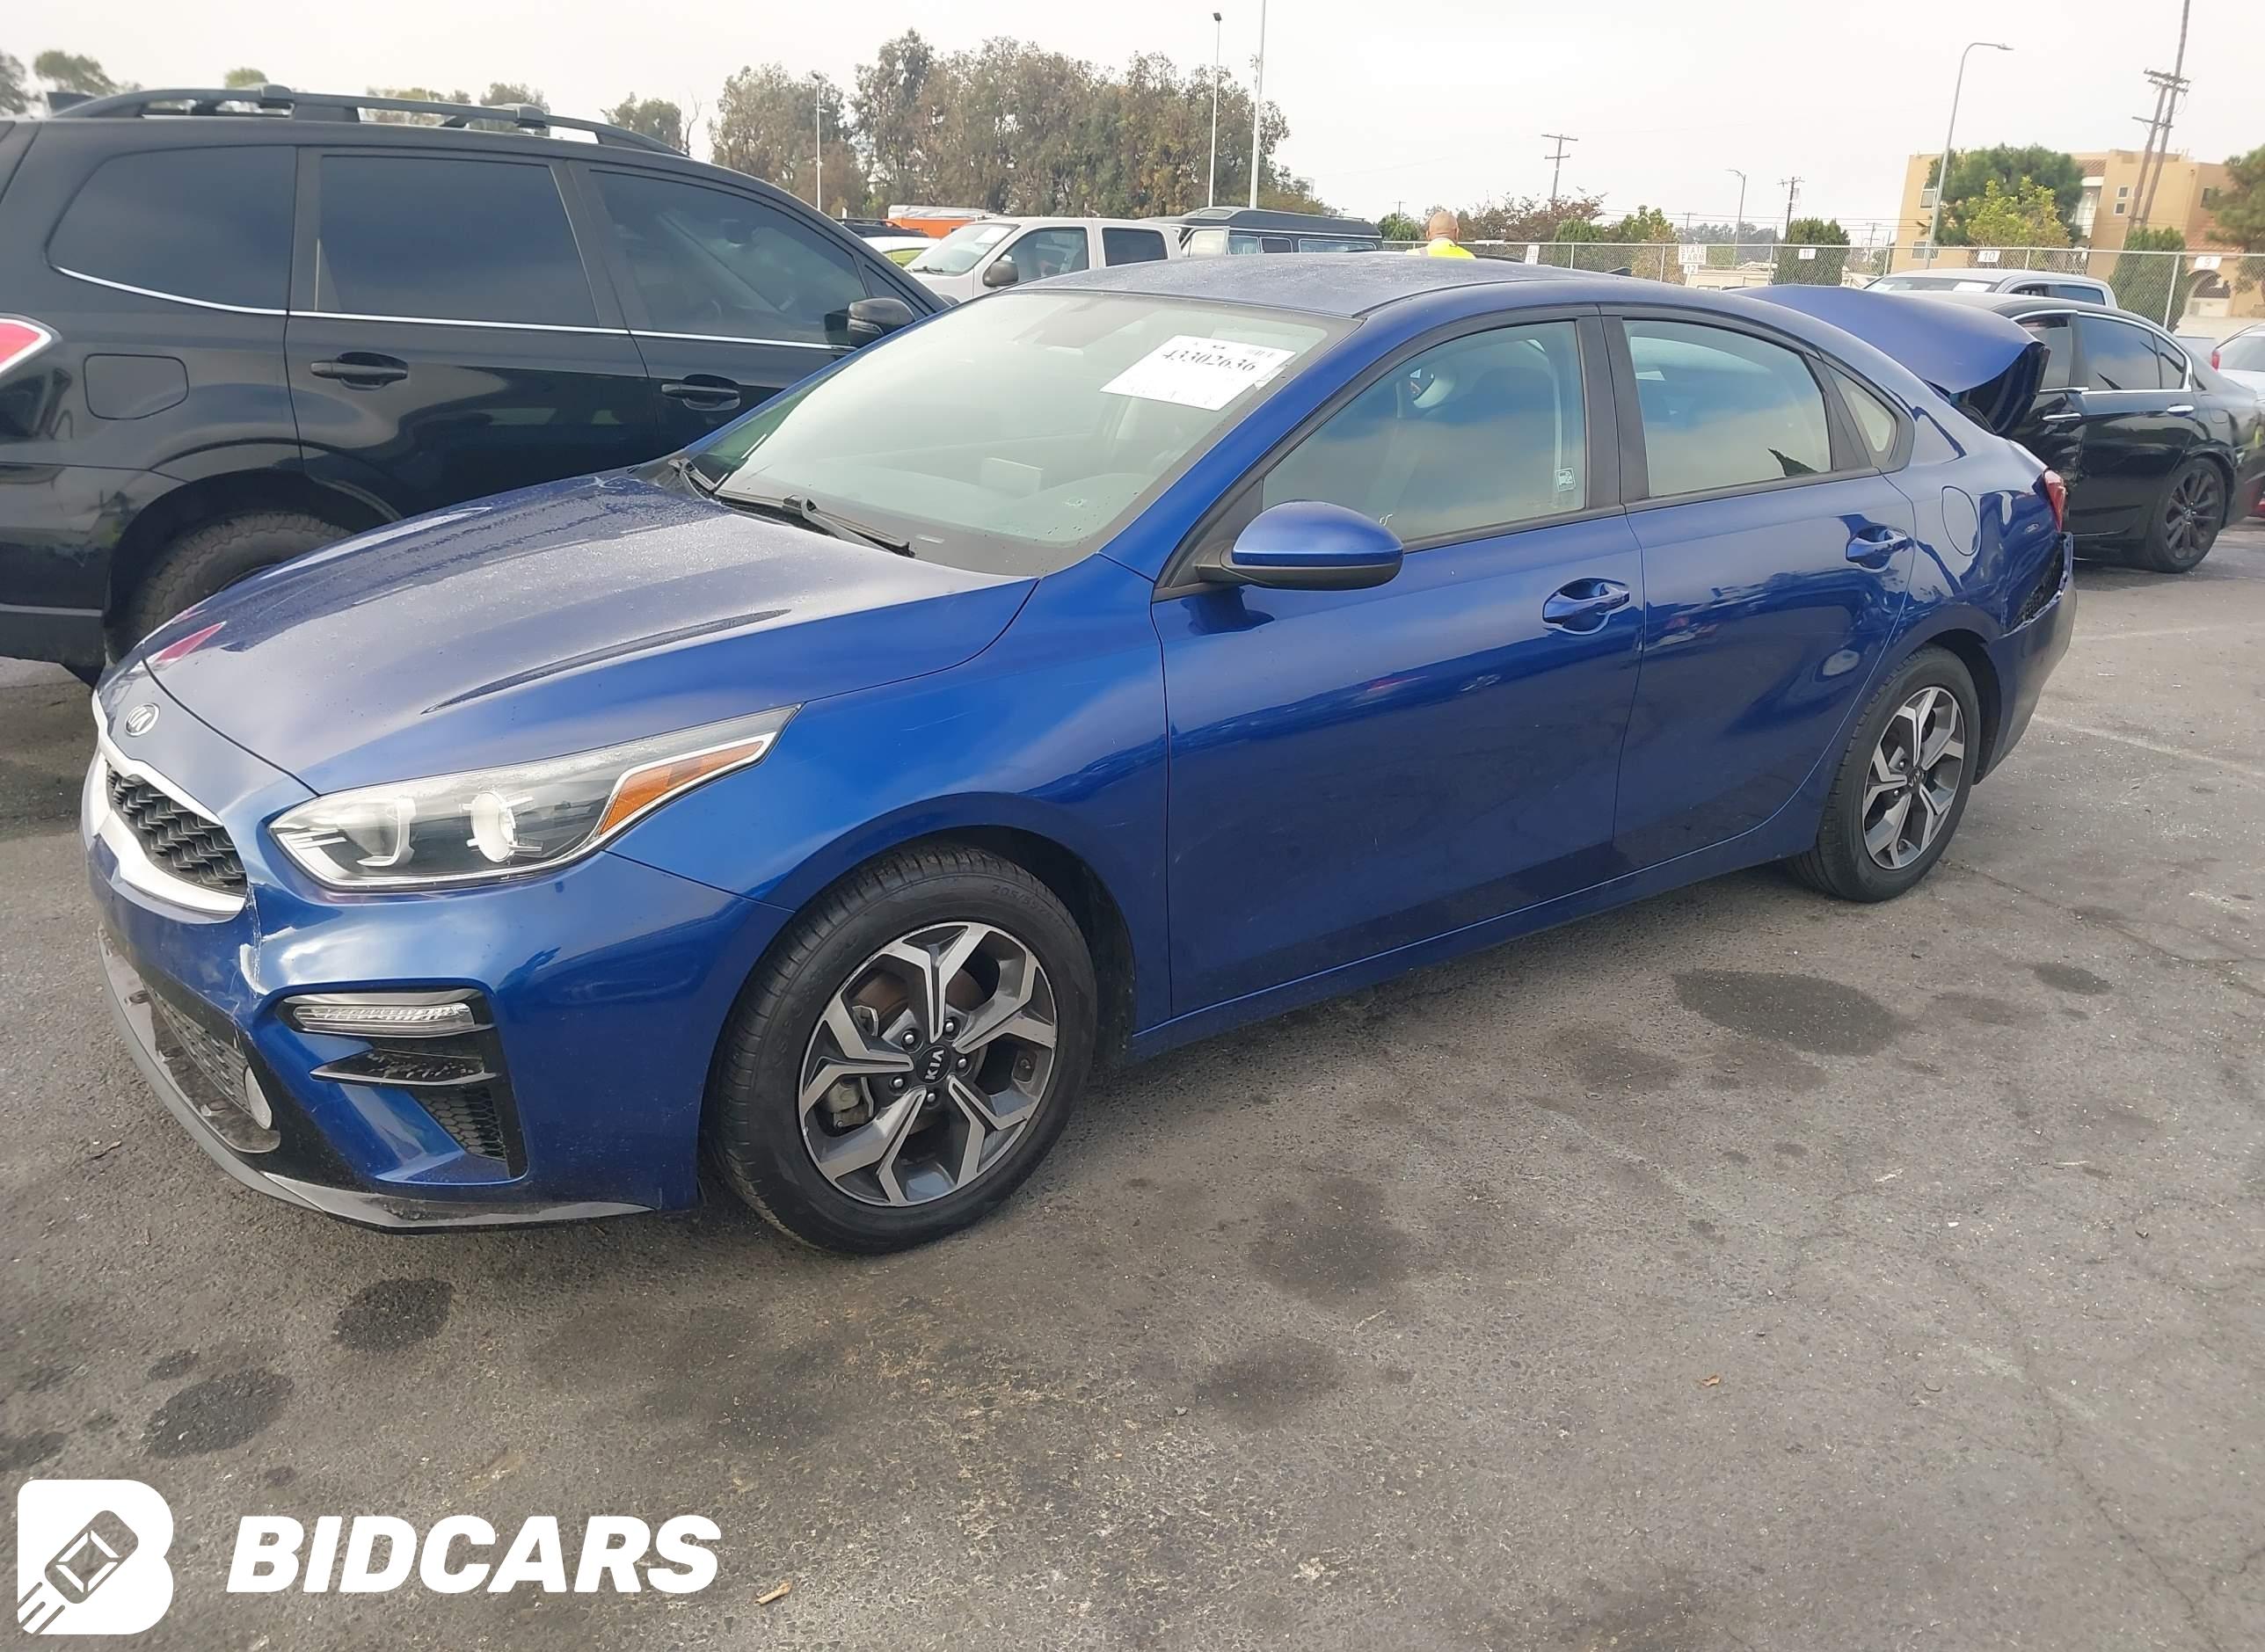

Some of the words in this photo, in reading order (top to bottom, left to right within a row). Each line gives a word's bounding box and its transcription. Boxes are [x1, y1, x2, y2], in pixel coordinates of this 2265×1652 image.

[1984, 251, 1996, 261] 10
[1687, 265, 1696, 273] 12
[1162, 349, 1256, 373] 43302636
[924, 1049, 945, 1080] KIA
